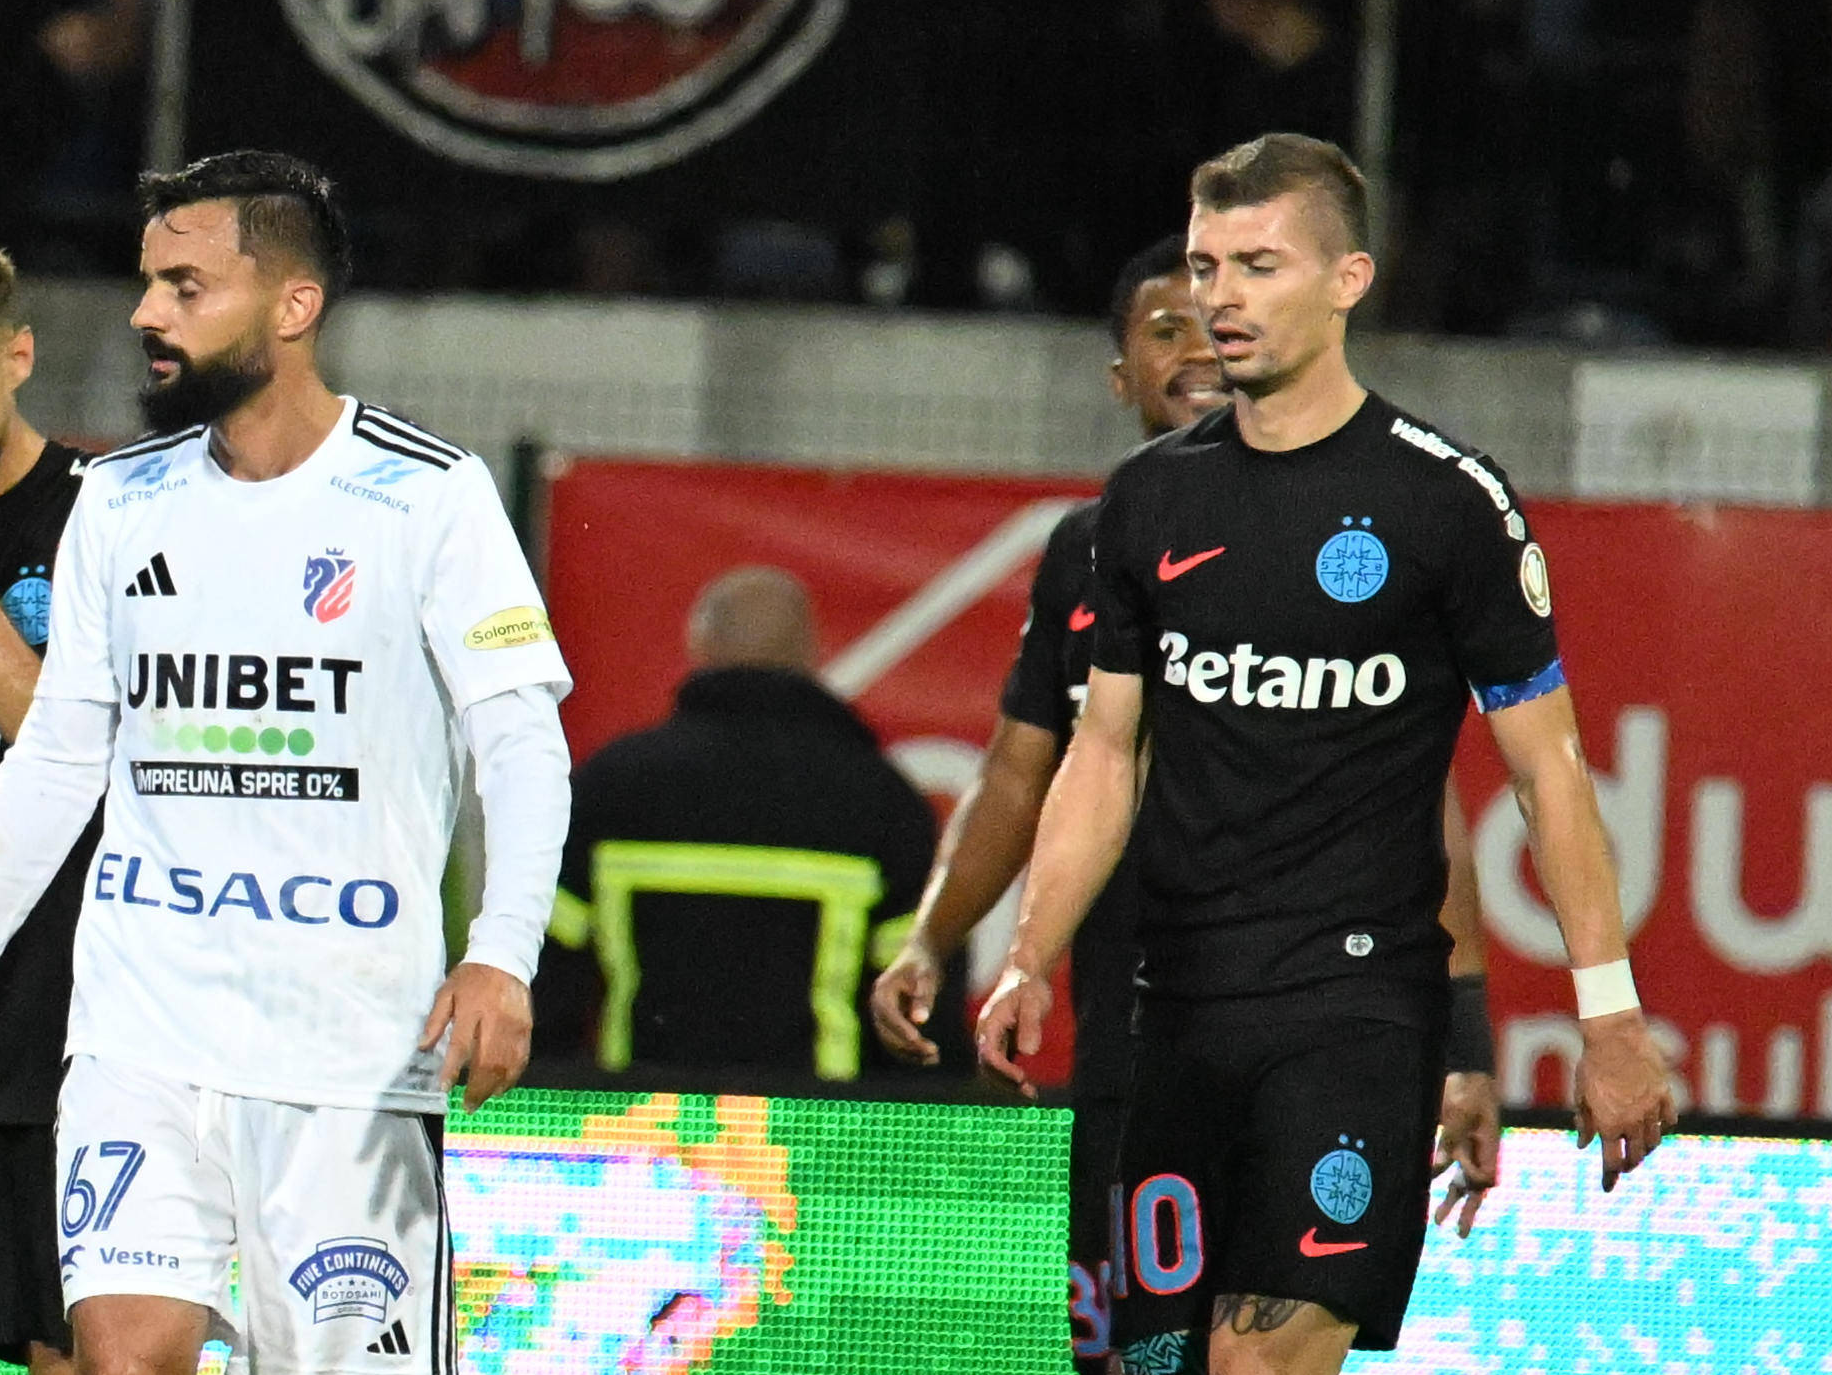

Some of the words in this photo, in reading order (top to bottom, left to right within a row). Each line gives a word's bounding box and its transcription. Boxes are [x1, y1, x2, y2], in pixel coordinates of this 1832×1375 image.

[127, 653, 363, 715] UNIBET
[240, 771, 300, 797] SPRE
[307, 772, 343, 799] 0%
[95, 852, 399, 929] ELSACO
[61, 1141, 146, 1239] 67
[99, 1246, 180, 1269] Vestra
[296, 1262, 323, 1292] FIVE
[323, 1252, 405, 1291] CONTINENTS
